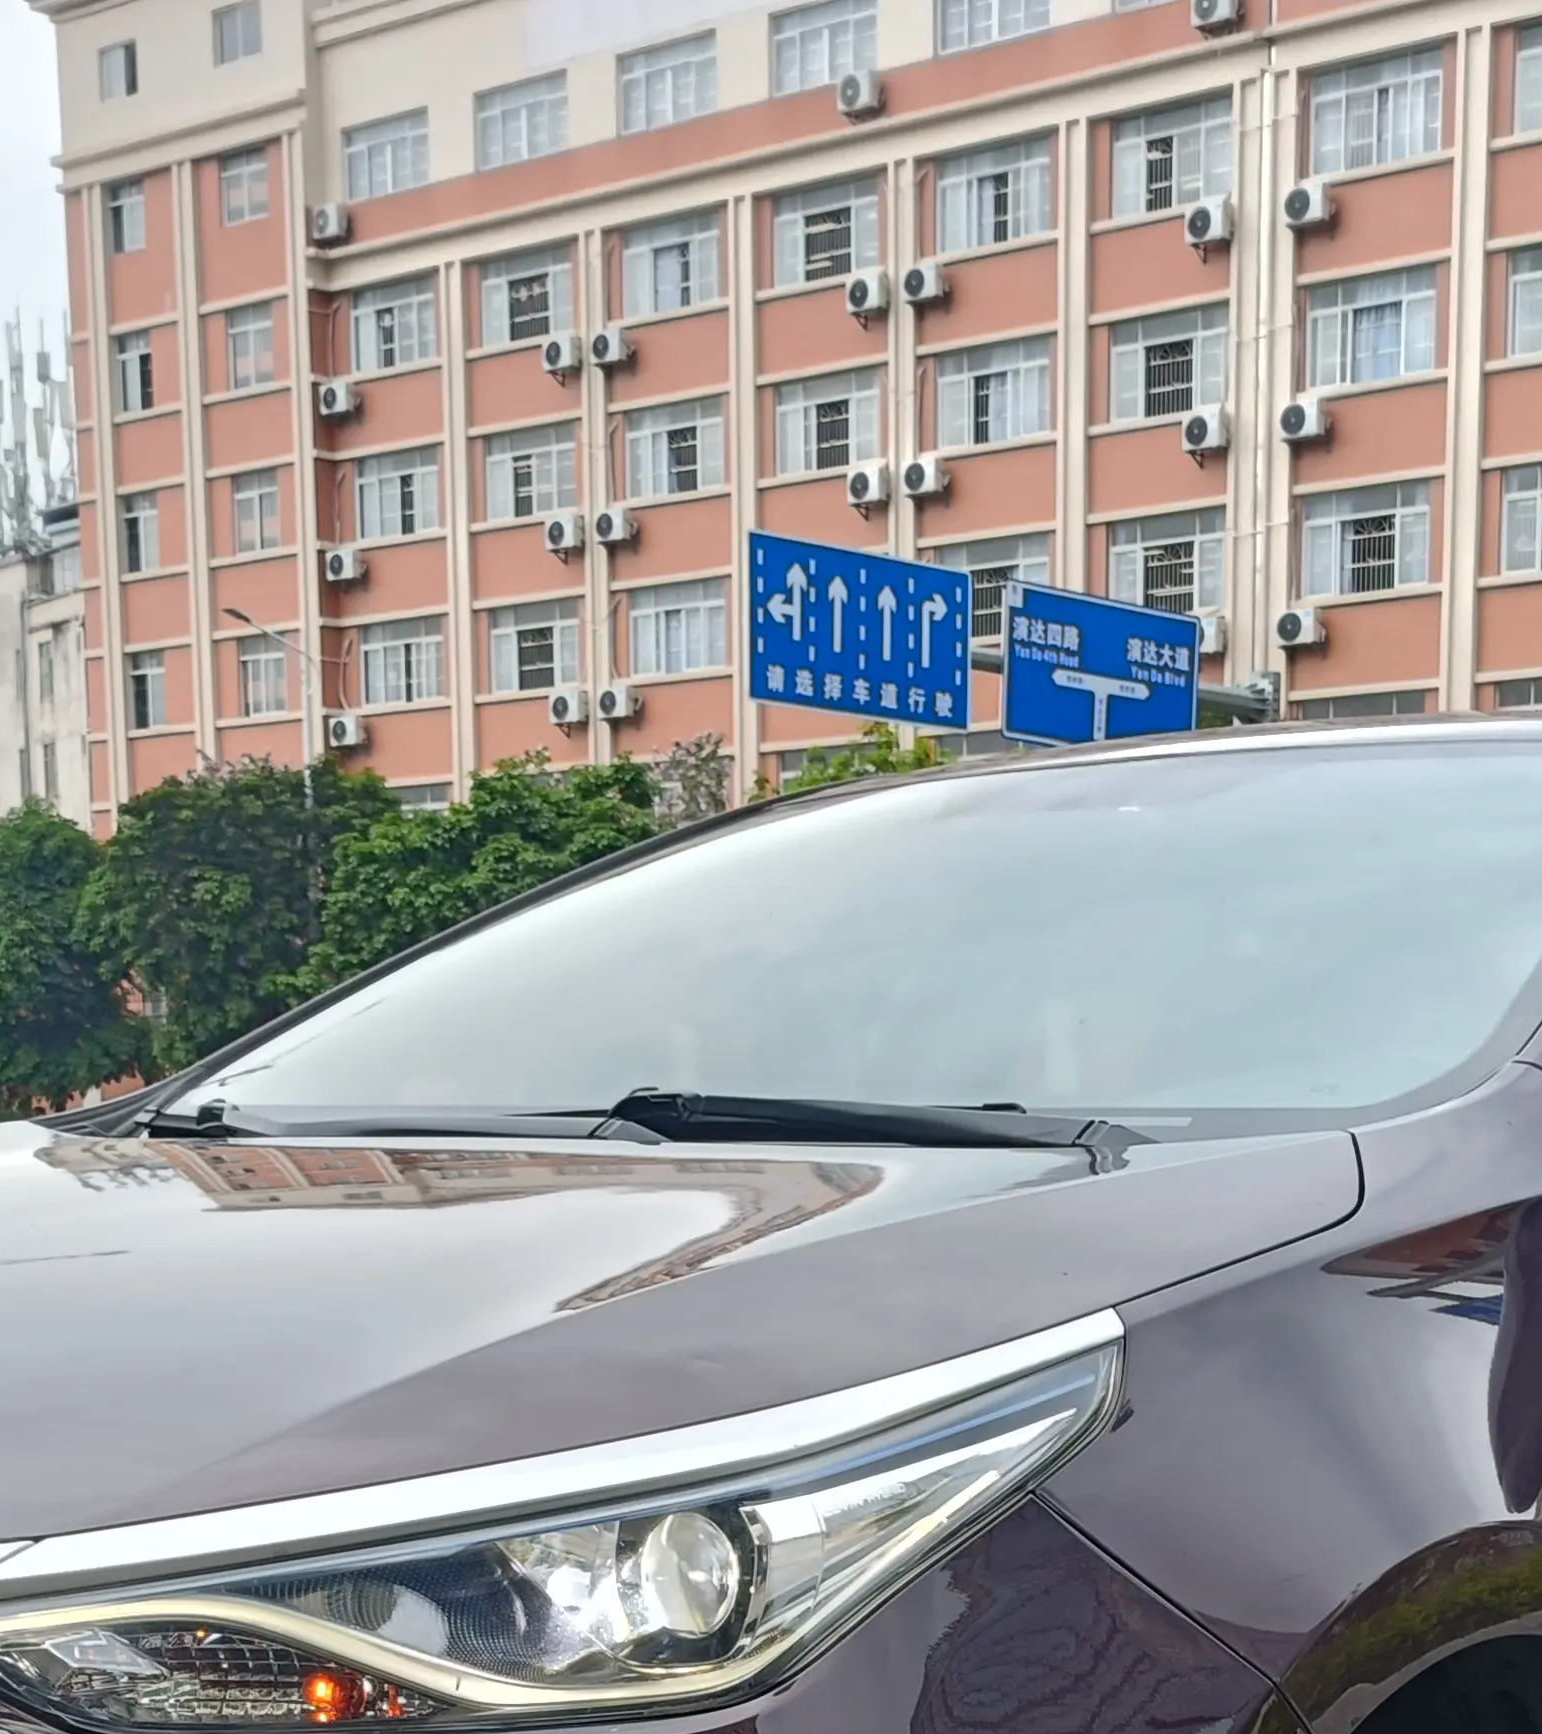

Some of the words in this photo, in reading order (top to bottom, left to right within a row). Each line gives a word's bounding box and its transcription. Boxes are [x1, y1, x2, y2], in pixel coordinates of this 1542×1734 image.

[1012, 616, 1080, 652] 演达四路
[1126, 637, 1190, 671] 演达大道
[766, 663, 953, 718] 请选择车道行驶
